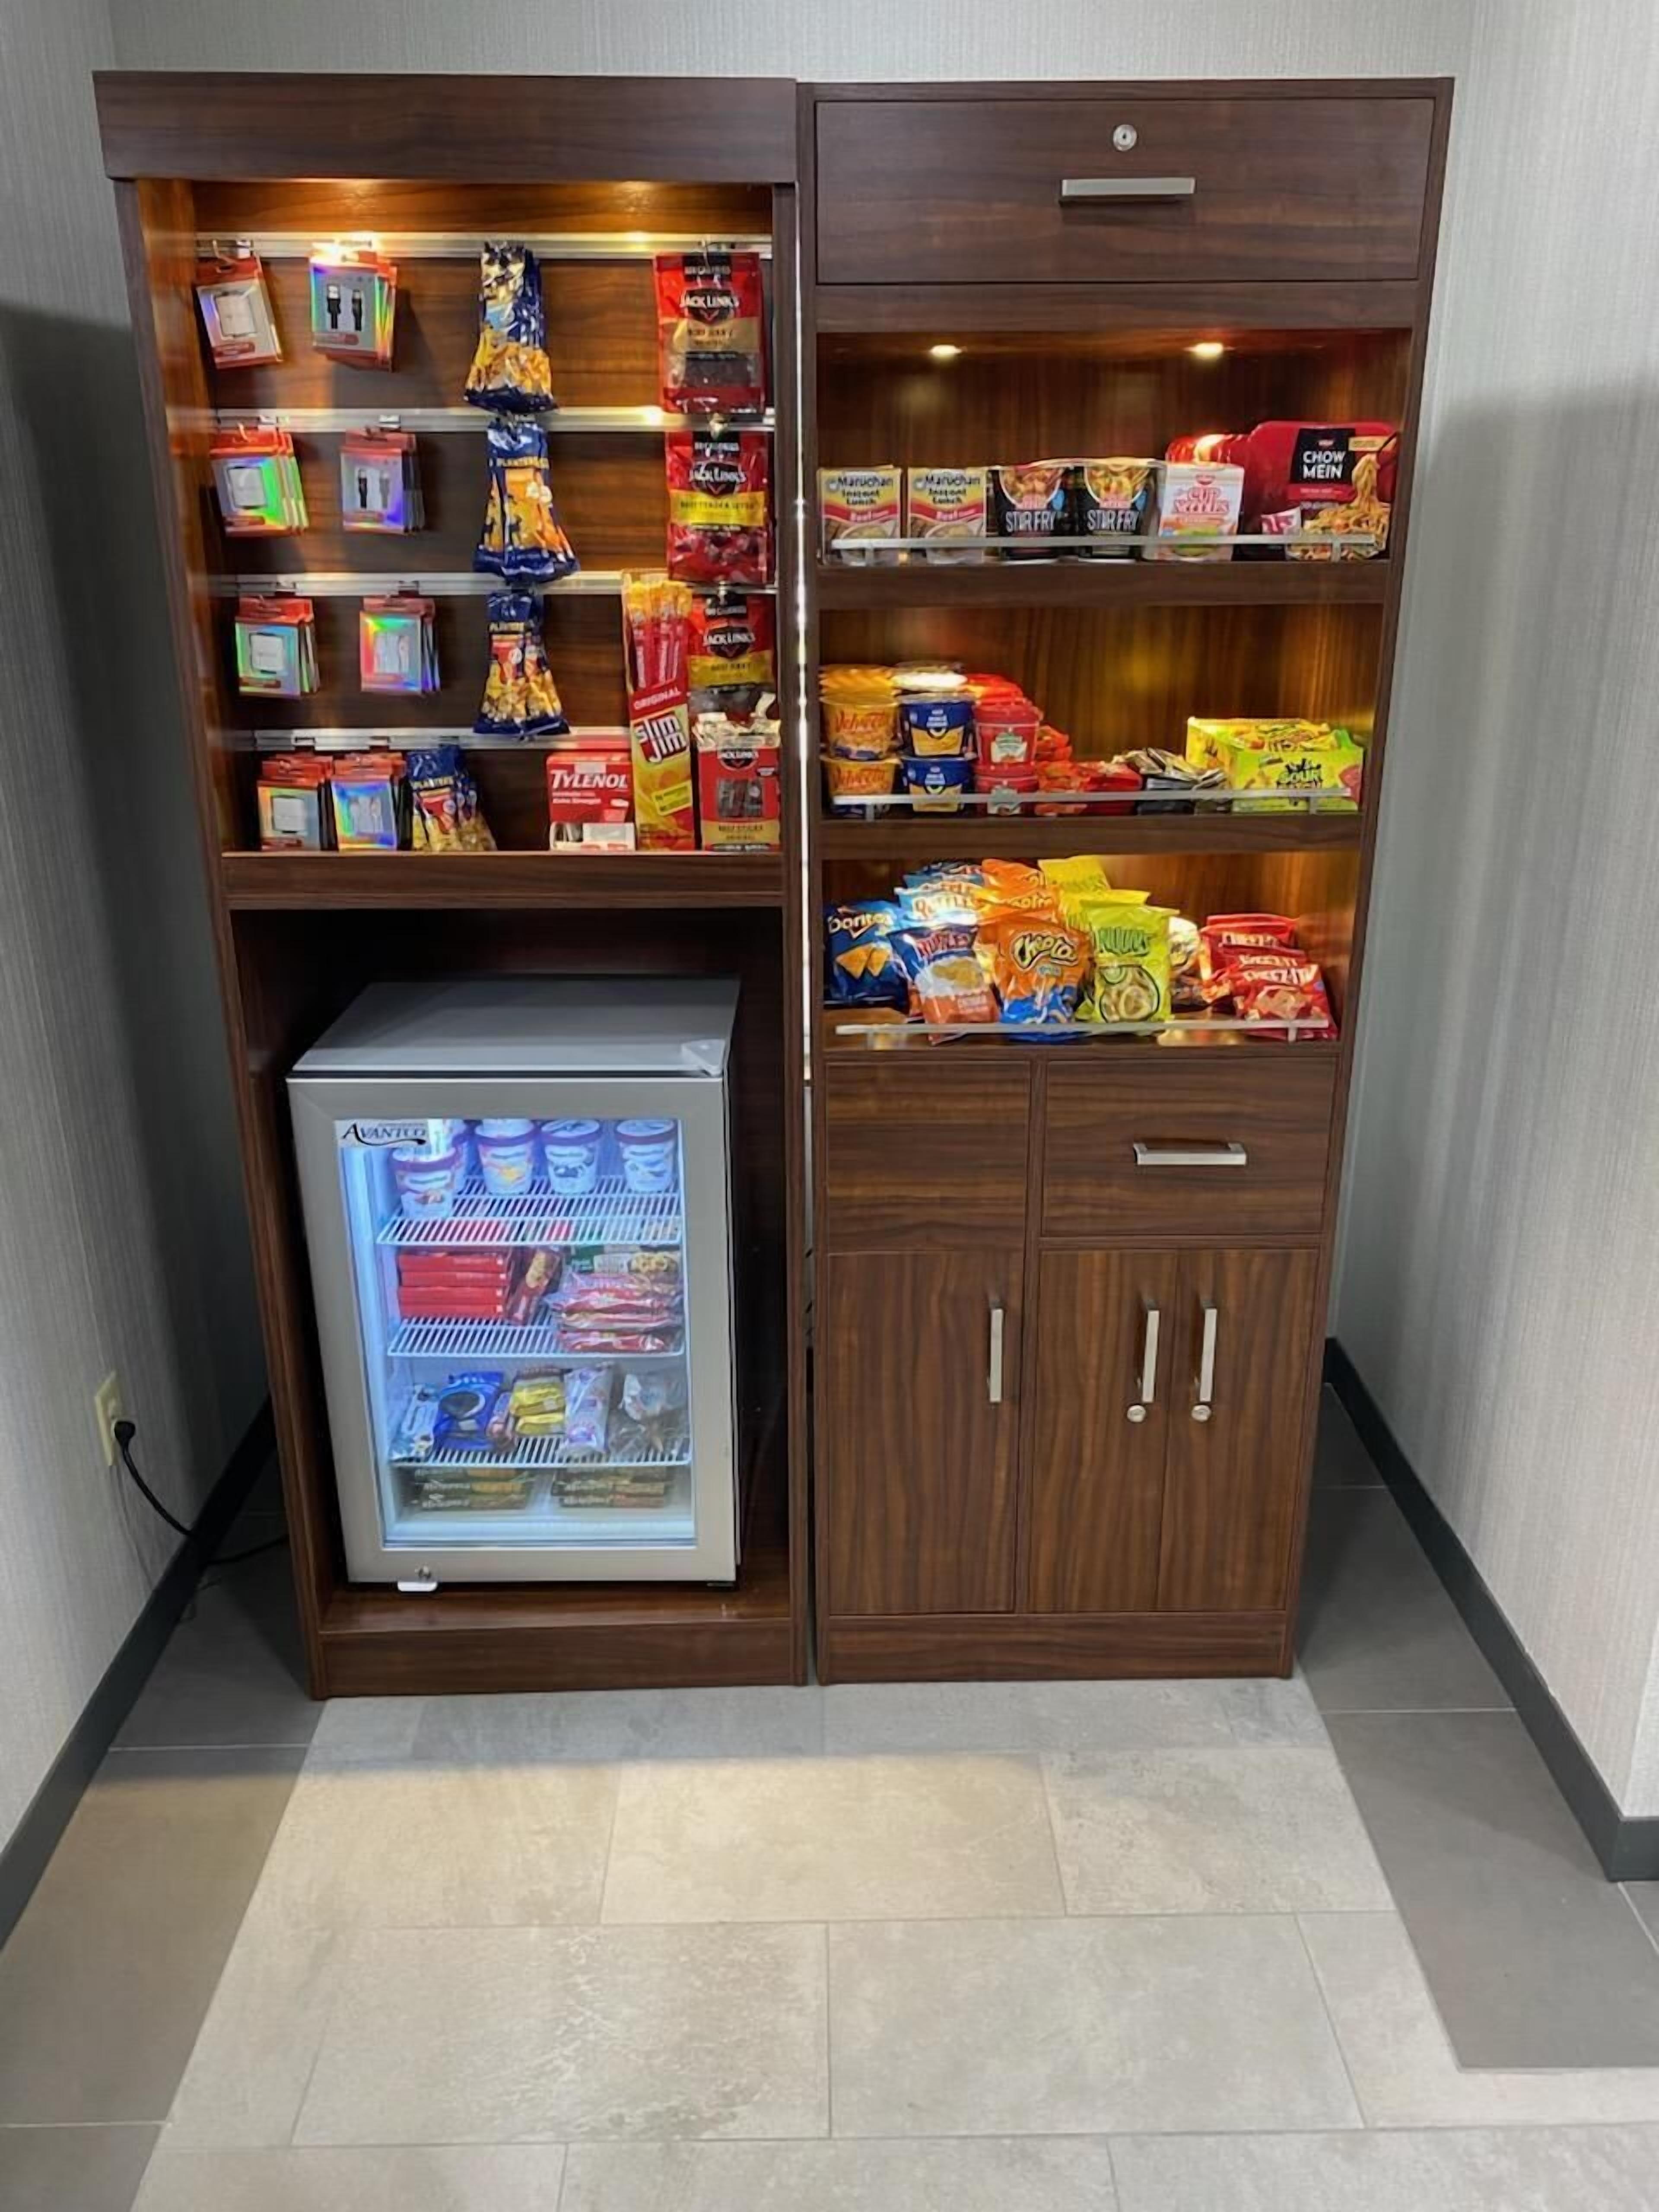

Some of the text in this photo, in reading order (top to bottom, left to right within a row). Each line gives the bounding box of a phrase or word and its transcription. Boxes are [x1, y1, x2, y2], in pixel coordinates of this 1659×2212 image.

[1303, 451, 1346, 464] CHOW
[1303, 464, 1343, 480] MEIN
[1006, 510, 1056, 533] STIR FRY
[1087, 509, 1141, 531] STIR FRY
[550, 769, 628, 789] TYLENOL
